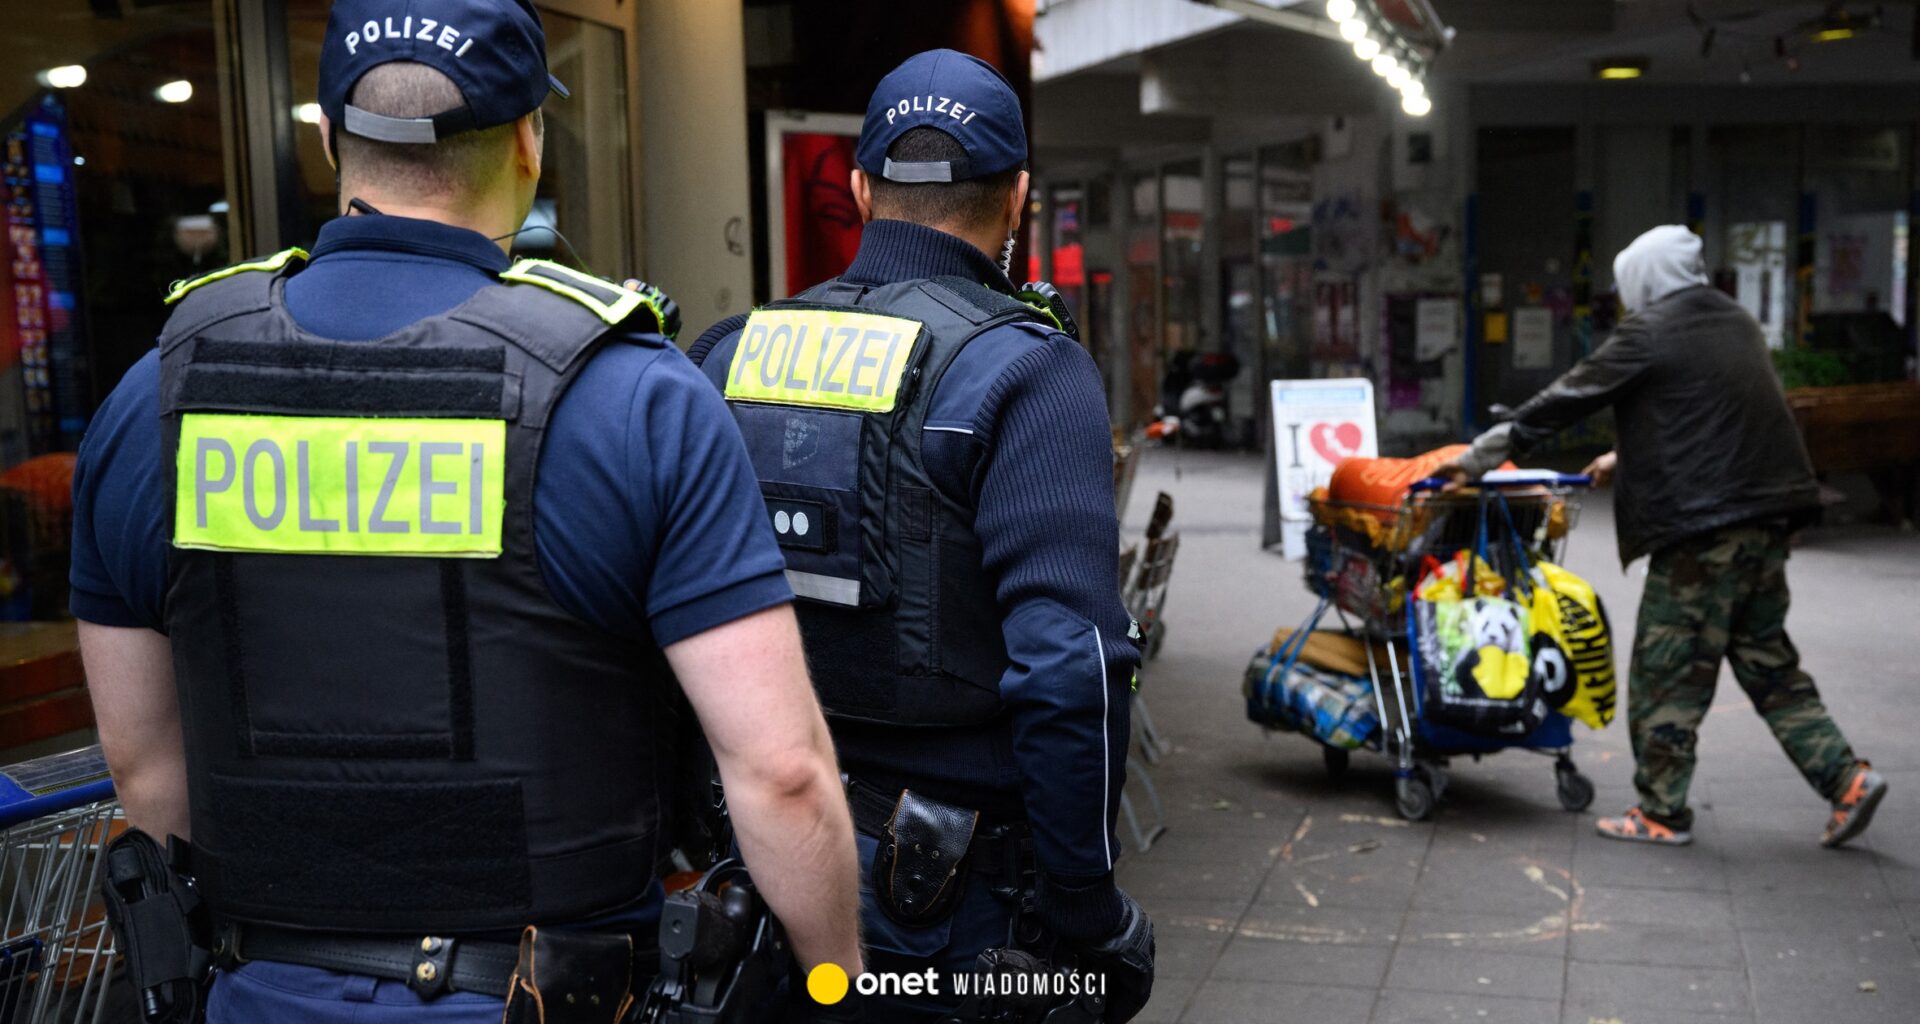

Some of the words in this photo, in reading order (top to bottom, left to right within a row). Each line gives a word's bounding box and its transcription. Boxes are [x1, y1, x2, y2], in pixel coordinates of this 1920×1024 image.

[344, 15, 474, 57] POLIZEI
[886, 95, 976, 125] POLIZEI
[733, 324, 902, 398] POLIZEI
[195, 436, 484, 535] POLIZEI
